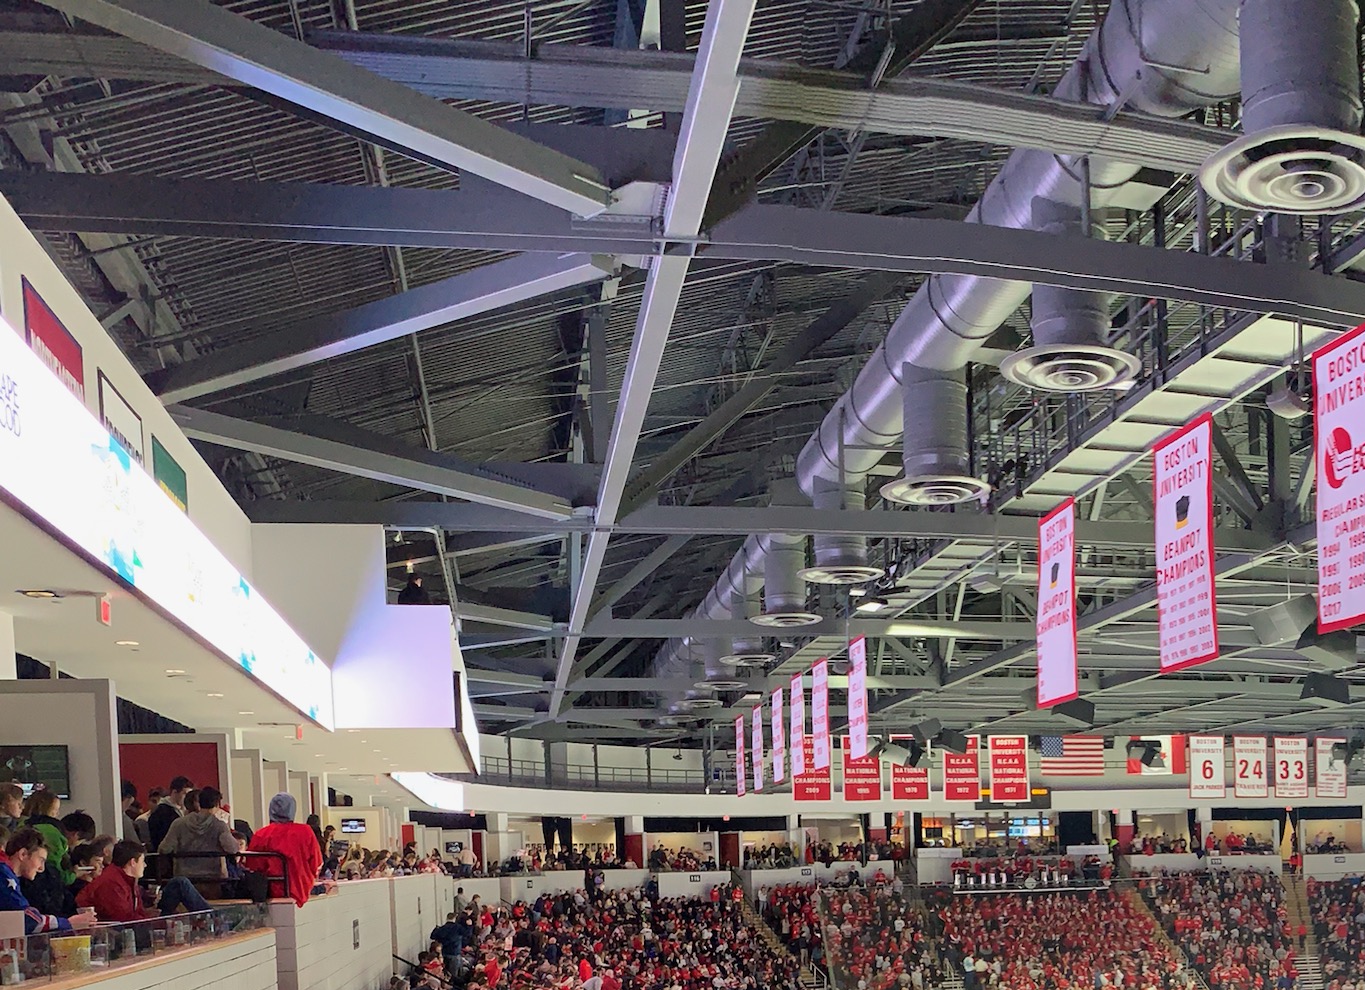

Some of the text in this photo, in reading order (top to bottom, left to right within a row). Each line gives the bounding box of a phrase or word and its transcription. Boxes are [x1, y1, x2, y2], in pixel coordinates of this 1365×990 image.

[1164, 437, 1198, 471] BOSTON
[1159, 458, 1207, 498] UNIVERSITY
[1164, 528, 1201, 561] BEANPOT
[1156, 550, 1205, 587] CHAMPIONS
[1202, 760, 1213, 779] 6
[1238, 759, 1263, 779] 24
[1279, 760, 1304, 779] 33
